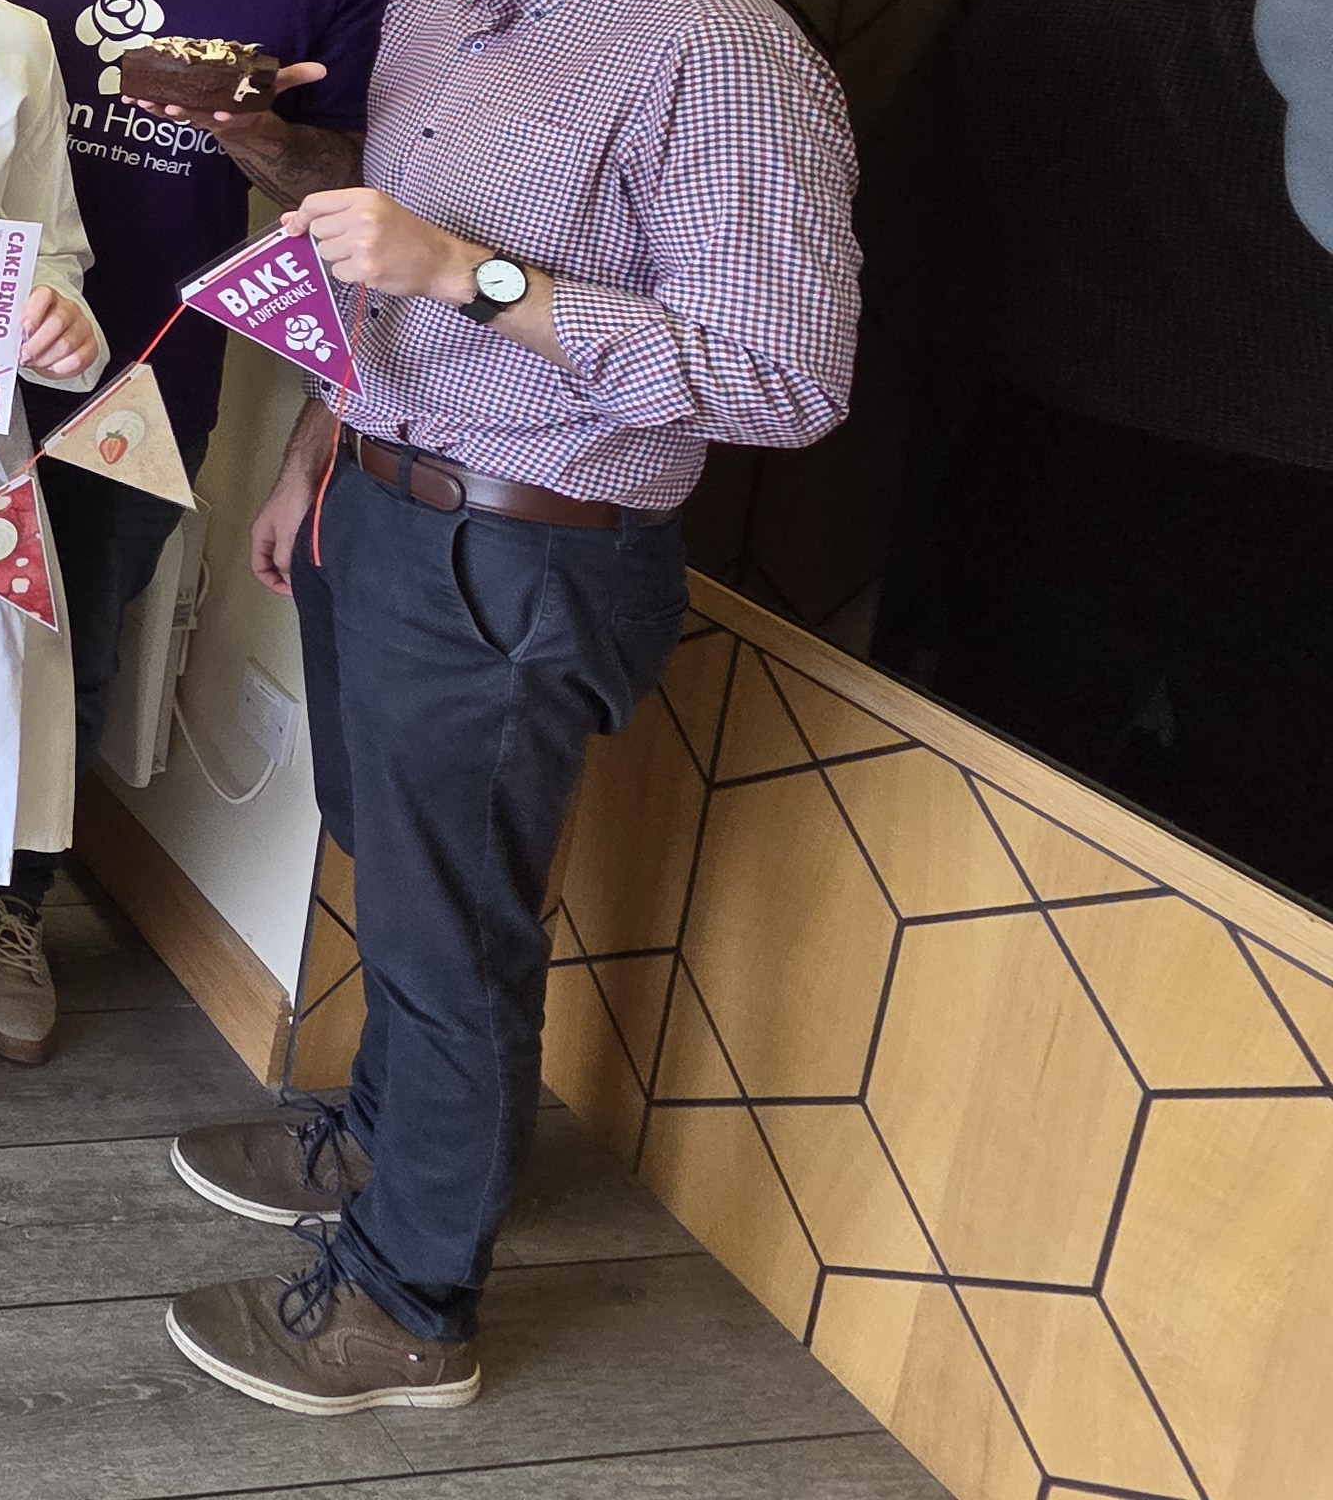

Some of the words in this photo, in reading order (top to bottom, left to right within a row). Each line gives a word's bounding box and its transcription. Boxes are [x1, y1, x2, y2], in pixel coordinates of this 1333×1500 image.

[111, 144, 141, 166] the
[144, 152, 193, 176] heart
[3, 232, 25, 277] CAKE
[217, 251, 310, 317] BAKE
[246, 316, 259, 329] A
[254, 280, 318, 322] DIFFERENCE
